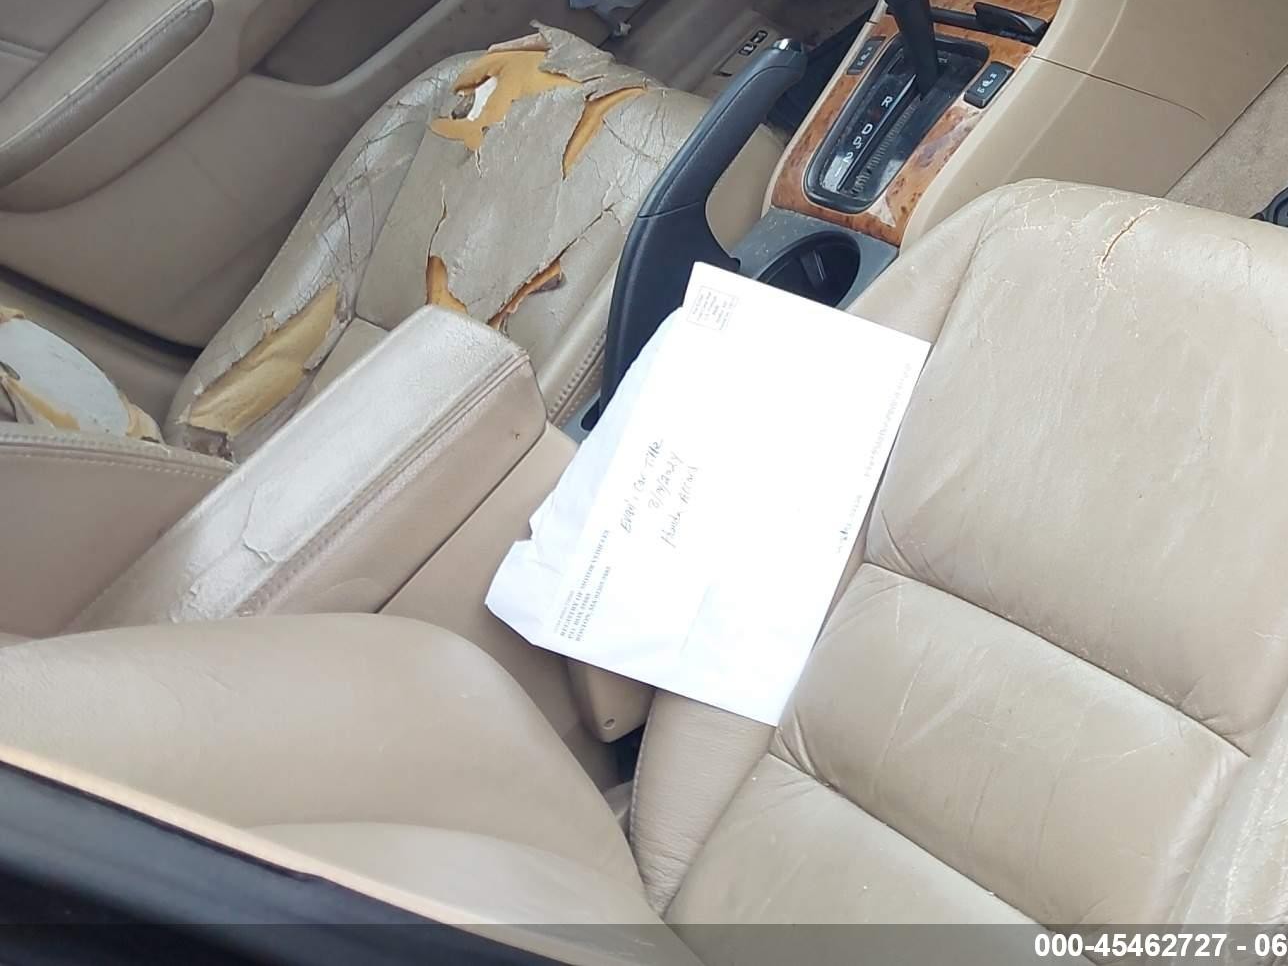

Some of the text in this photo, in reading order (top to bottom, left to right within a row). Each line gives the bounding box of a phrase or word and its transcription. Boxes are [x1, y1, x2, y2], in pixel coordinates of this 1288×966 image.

[881, 96, 893, 108] R
[861, 123, 874, 134] D
[843, 152, 854, 163] 2
